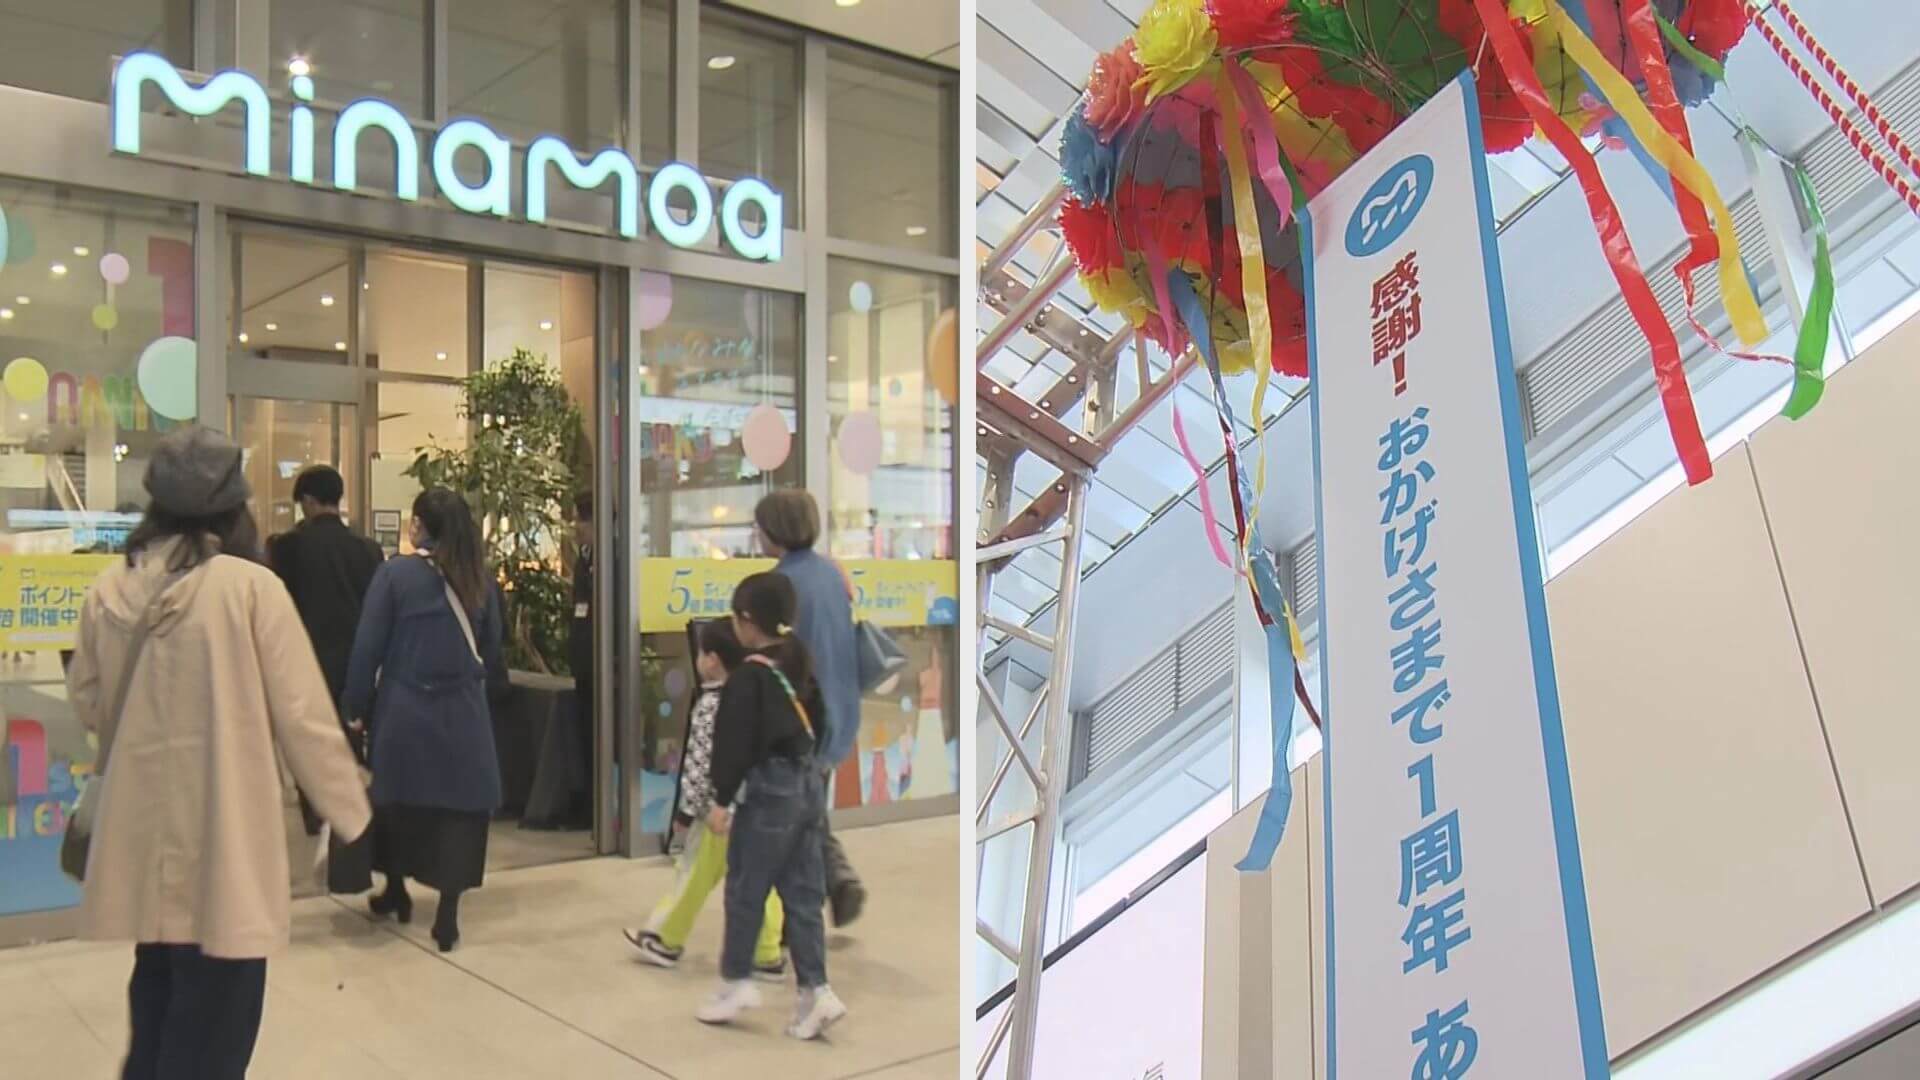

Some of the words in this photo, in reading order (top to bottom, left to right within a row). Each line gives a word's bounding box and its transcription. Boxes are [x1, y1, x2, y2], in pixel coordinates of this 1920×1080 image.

[112, 49, 783, 263] minamoa
[1370, 250, 1421, 397] 感謝!
[20, 585, 91, 605] ポイント
[1377, 406, 1472, 975] おかげさまで1周年
[1411, 998, 1478, 1080] あ
